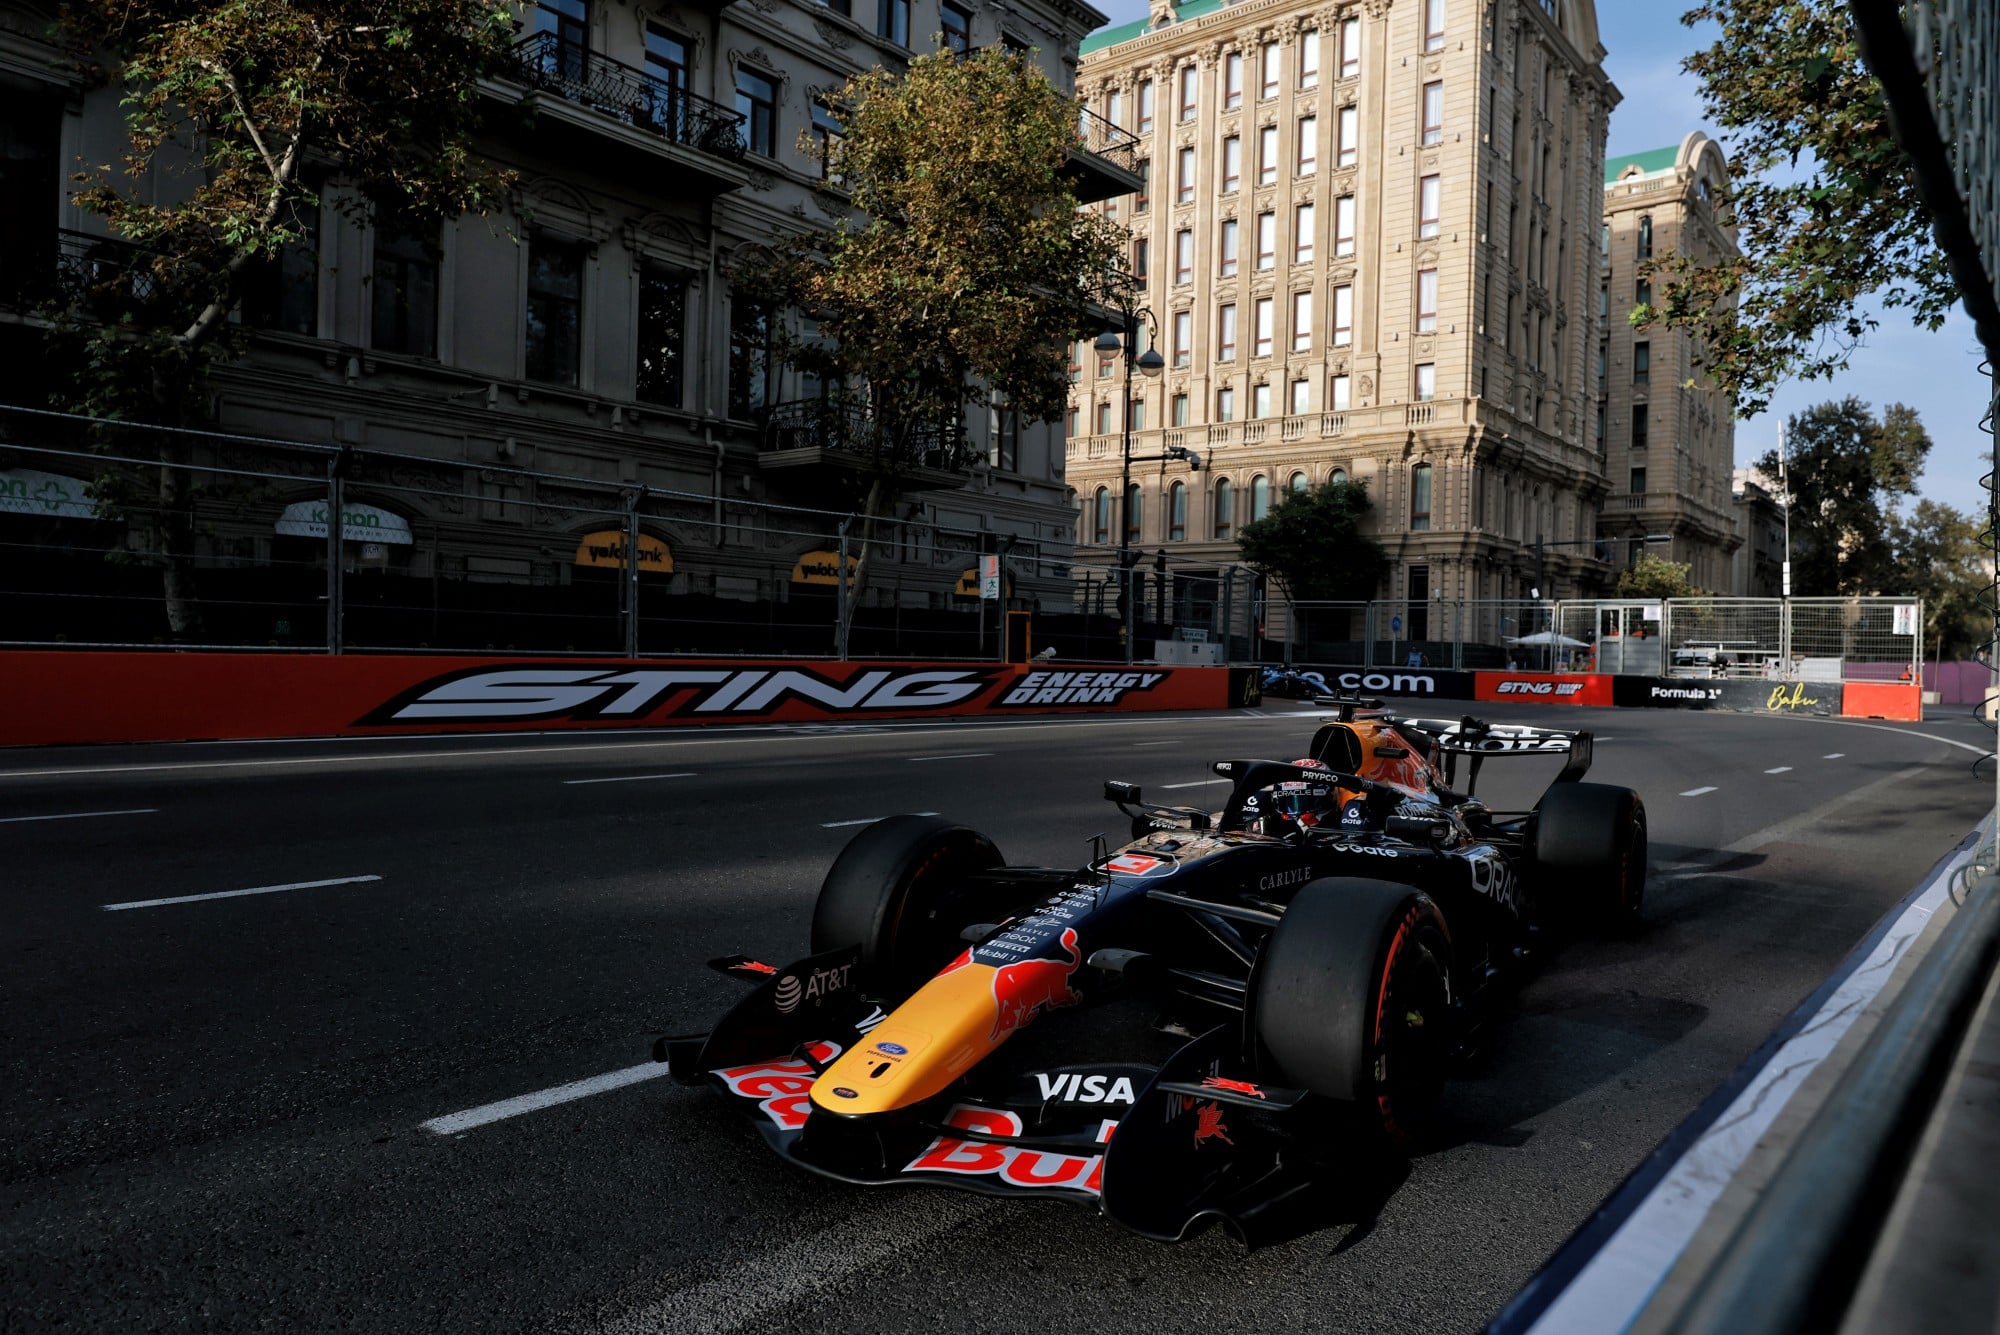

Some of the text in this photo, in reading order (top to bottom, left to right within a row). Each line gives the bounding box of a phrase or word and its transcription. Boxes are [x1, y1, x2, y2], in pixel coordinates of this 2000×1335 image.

[1018, 671, 1163, 688] ENERGY
[391, 670, 984, 718] STING
[1496, 681, 1553, 694] STING
[1650, 686, 1706, 700] Formula
[1001, 687, 1124, 704] DRINK
[1766, 682, 1819, 711] Baku
[1302, 770, 1339, 783] PRYPCO
[1277, 789, 1312, 797] ORACLE
[1350, 843, 1399, 858] Gate
[1259, 866, 1312, 892] CARLYLE
[1034, 908, 1074, 919] TRADE
[976, 948, 1009, 960] Mobil
[804, 963, 852, 1000] AT&T
[866, 1050, 902, 1063] RACING
[1033, 1072, 1136, 1105] VISA
